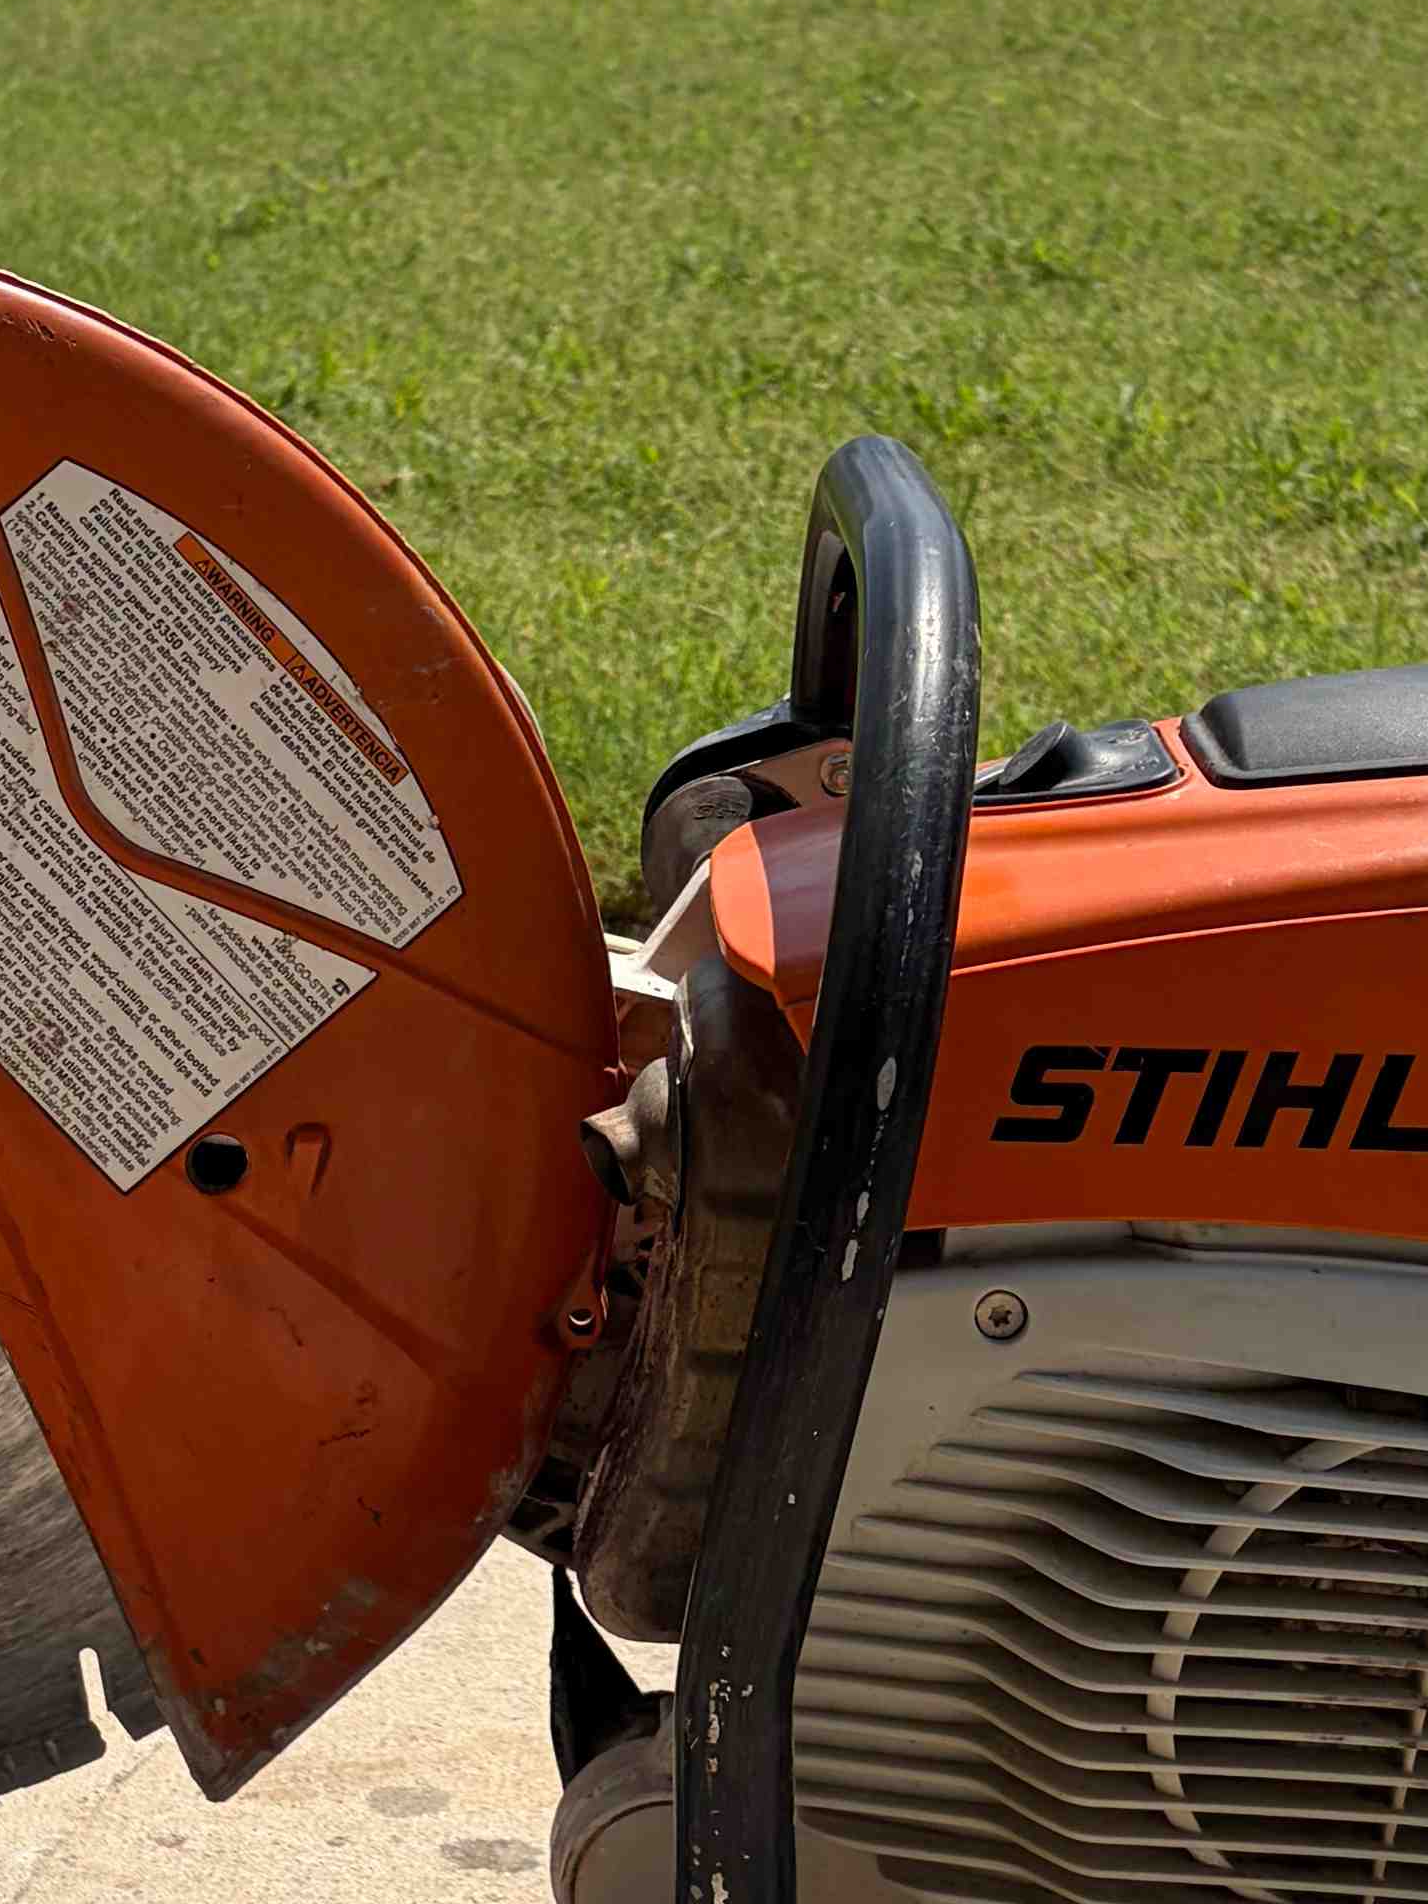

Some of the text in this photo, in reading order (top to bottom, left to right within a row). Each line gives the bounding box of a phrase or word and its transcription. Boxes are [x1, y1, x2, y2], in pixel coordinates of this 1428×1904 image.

[35, 510, 77, 557] Carefully
[75, 556, 106, 588] select
[103, 587, 126, 607] and
[142, 627, 159, 644] for
[44, 501, 90, 552] Maximum
[88, 551, 124, 589] spindle
[123, 588, 155, 621] speed
[152, 618, 183, 649] 5350
[79, 516, 226, 673] can cause serious or fatal injury!
[88, 505, 242, 673] Failure to follow these instructions
[99, 498, 251, 664] on label and in instruction manual.
[108, 488, 275, 672] Read and follow all safety precautions
[205, 566, 277, 642] WARNING
[0, 737, 36, 776] sudden
[105, 743, 207, 849] Never use damaged or
[118, 736, 159, 780] increase
[157, 780, 195, 819] reactive
[194, 817, 224, 850] forces
[134, 735, 168, 771] wheels
[166, 771, 189, 793] may
[187, 791, 201, 807] be
[200, 806, 226, 833] more
[224, 830, 251, 859] likely
[249, 857, 261, 870] to
[249, 701, 283, 734] causar
[280, 734, 309, 765] daños
[306, 764, 358, 818] personales
[355, 817, 389, 850] graves
[387, 850, 396, 858] o
[259, 691, 418, 863] instrucciones. El uso indebido puede
[269, 683, 435, 863] de seguridad incluidas en el manual de
[278, 673, 424, 832] Lea y siga todas las precauciones
[301, 673, 402, 781] ADVERTENCIA
[15, 776, 40, 799] may
[38, 799, 67, 829] cause
[66, 827, 88, 851] loss
[86, 850, 102, 862] of
[98, 862, 134, 897] control
[130, 896, 152, 917] and
[148, 914, 177, 944] injury
[174, 944, 188, 956] or
[29, 805, 42, 821] To
[40, 821, 74, 855] reduce
[72, 855, 93, 875] risk
[91, 874, 106, 886] of
[144, 931, 173, 959] avoid
[169, 958, 203, 993] cutting
[201, 991, 222, 1013] with
[220, 1012, 249, 1040] upper
[4, 862, 25, 881] any
[90, 951, 149, 1014] wood-cutting
[147, 1012, 161, 1024] or
[159, 1024, 185, 1049] other
[183, 1048, 220, 1086] toothed
[20, 897, 34, 909] or
[31, 909, 59, 938] death
[57, 935, 81, 962] from
[79, 959, 107, 988] blade
[141, 1024, 174, 1060] thrown
[172, 1057, 192, 1078] tips
[191, 1077, 212, 1097] and
